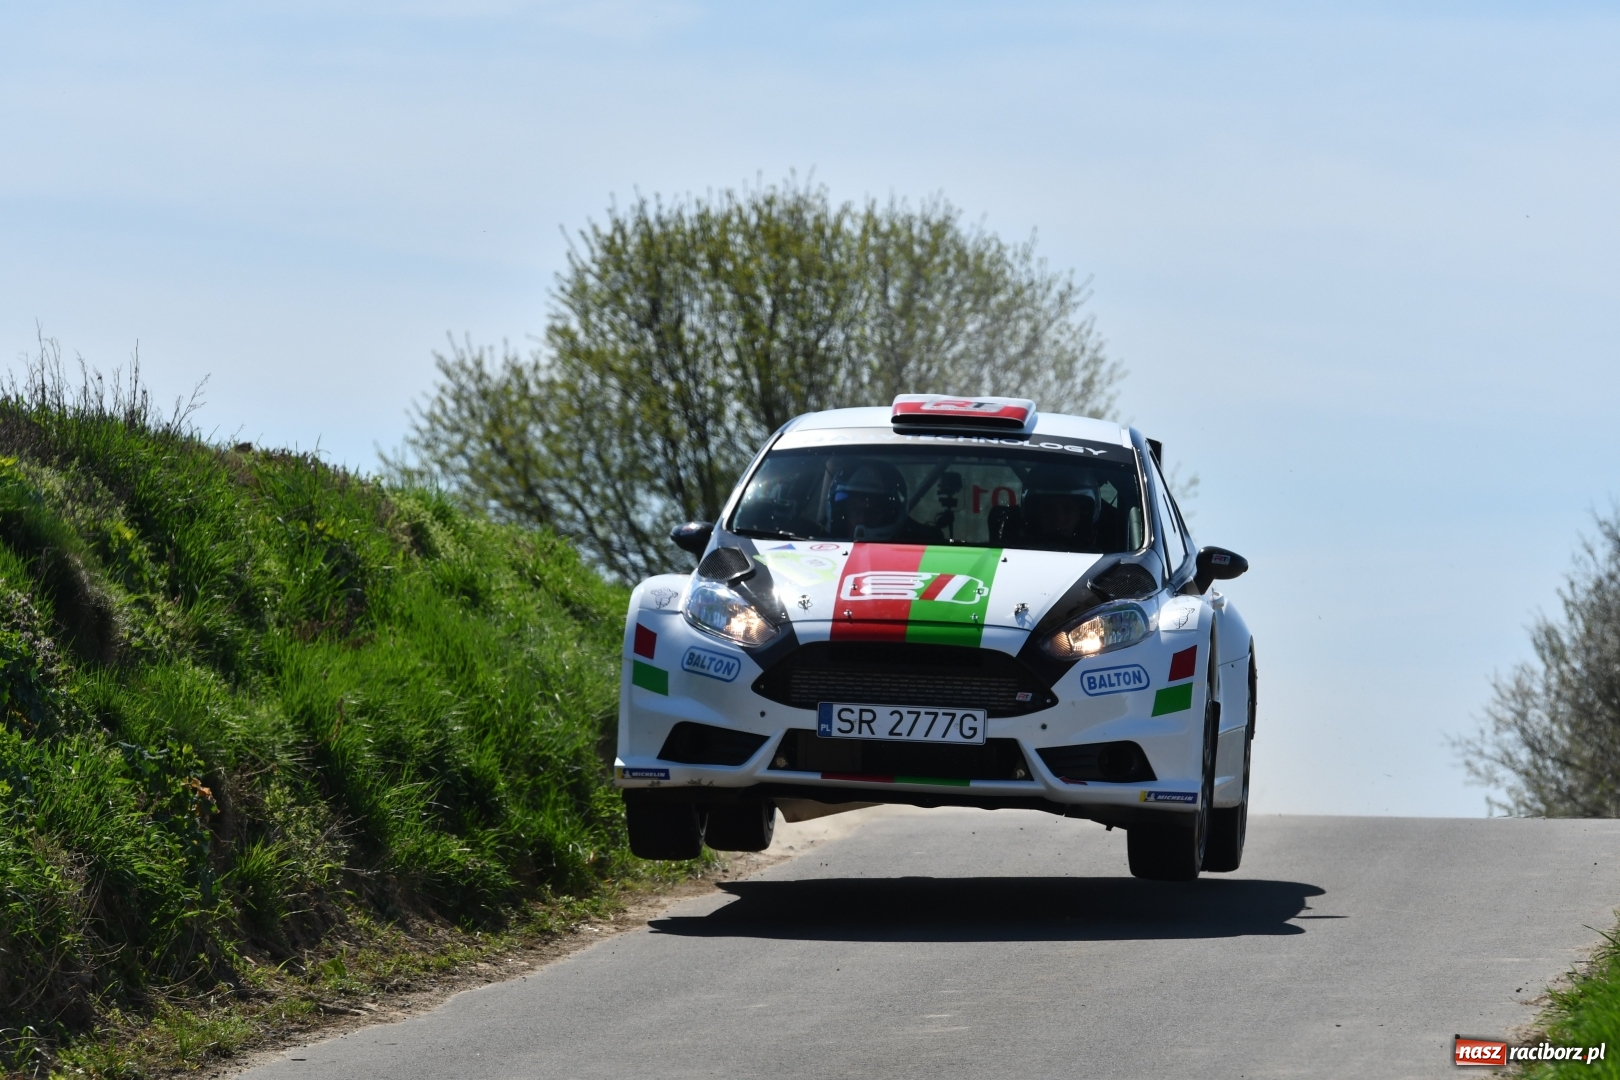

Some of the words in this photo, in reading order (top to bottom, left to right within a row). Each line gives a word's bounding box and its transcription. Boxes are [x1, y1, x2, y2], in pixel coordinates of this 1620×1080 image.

[904, 432, 1108, 456] TECHNOLOGY
[685, 650, 736, 676] BALTON
[1086, 670, 1143, 691] BALTON
[820, 723, 831, 732] PL
[836, 707, 876, 735] SR
[888, 709, 978, 740] 2777G
